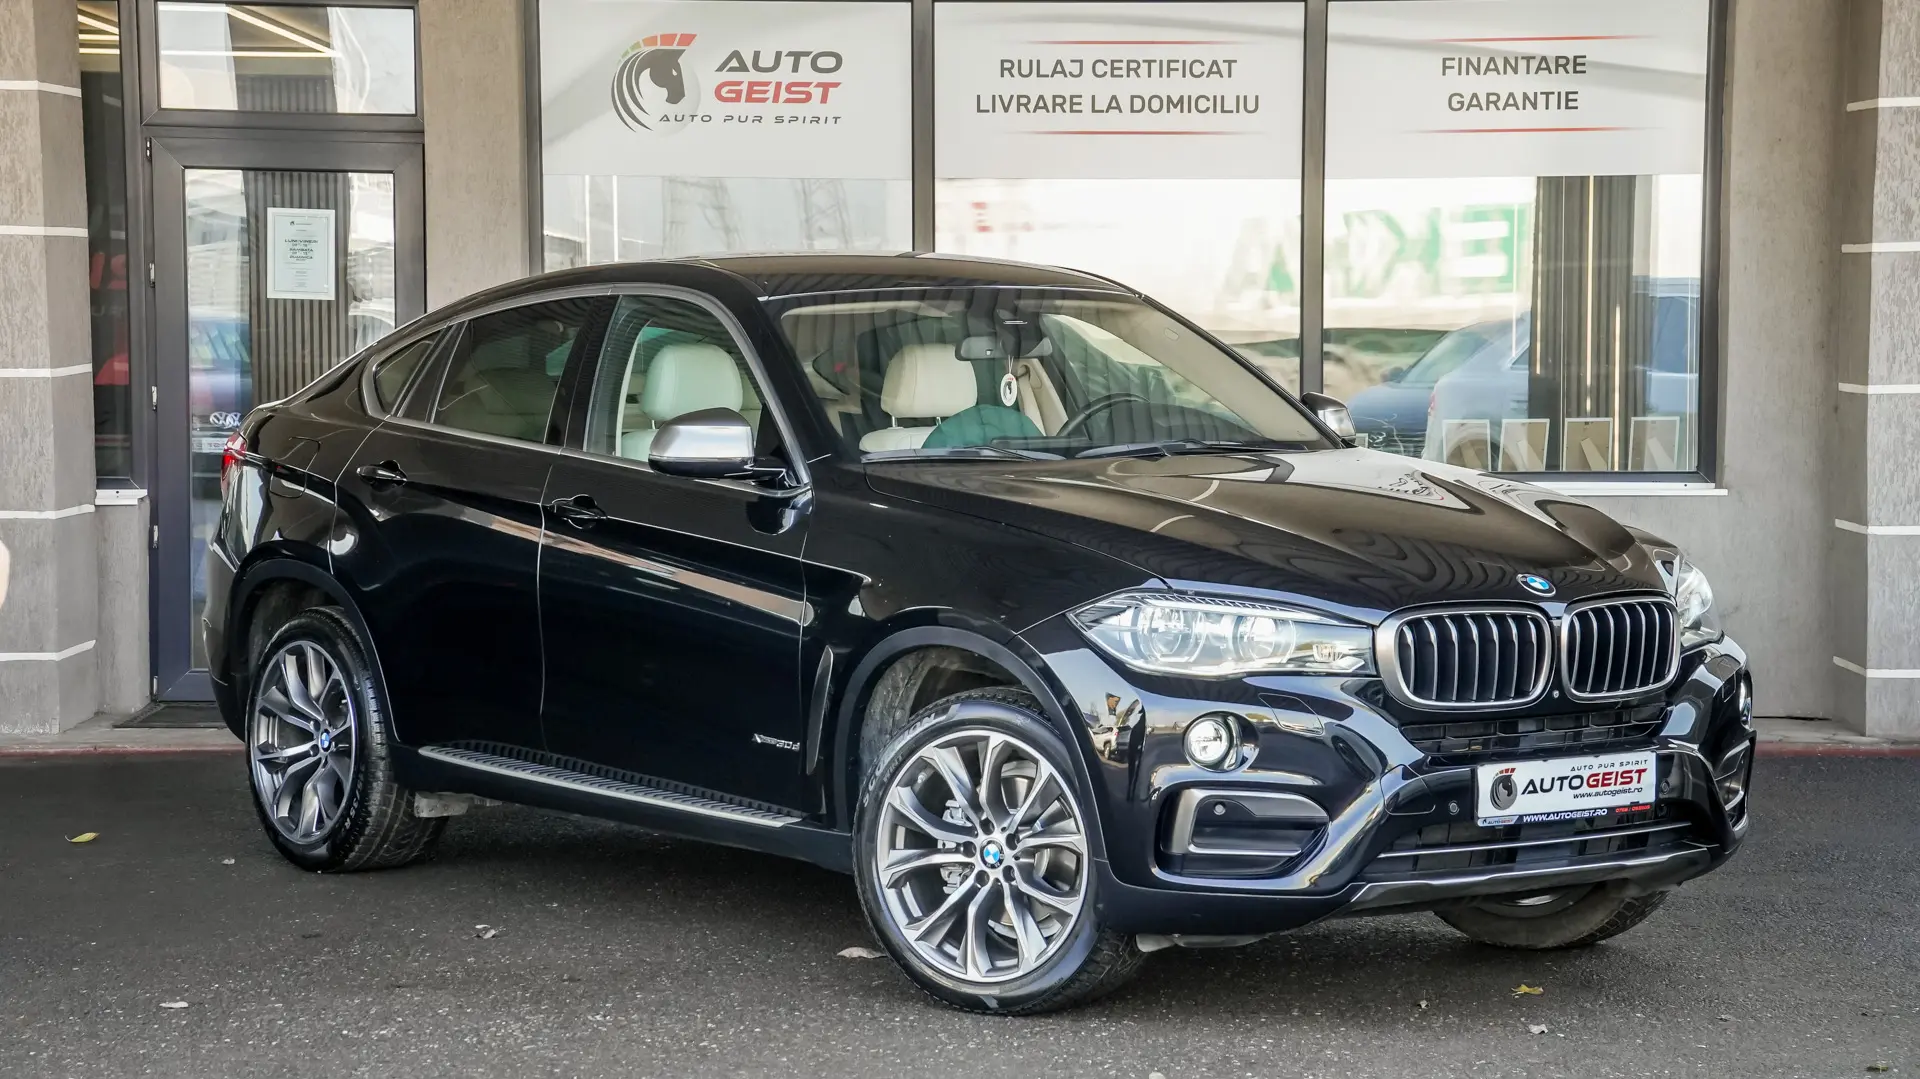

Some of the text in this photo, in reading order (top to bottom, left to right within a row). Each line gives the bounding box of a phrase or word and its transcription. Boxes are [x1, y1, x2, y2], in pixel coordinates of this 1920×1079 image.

[714, 50, 843, 74] AUTO
[1000, 59, 1237, 79] RULAJ CERTIFICAT
[1441, 55, 1587, 76] FINANTARE
[714, 80, 842, 104] GEIST
[1447, 91, 1579, 112] GARANTIE
[976, 94, 1260, 114] LIVRARE LA DOMICILIU
[659, 114, 842, 125] AUTO PUR SPIRIT
[1570, 764, 1594, 772] AUTO
[1619, 759, 1648, 767] SPIRIT
[1521, 768, 1648, 795] AUTOGEIST
[1573, 787, 1643, 800] www.autogeist.ro
[1523, 808, 1608, 823] WWW.AUTOGEIST.RO
